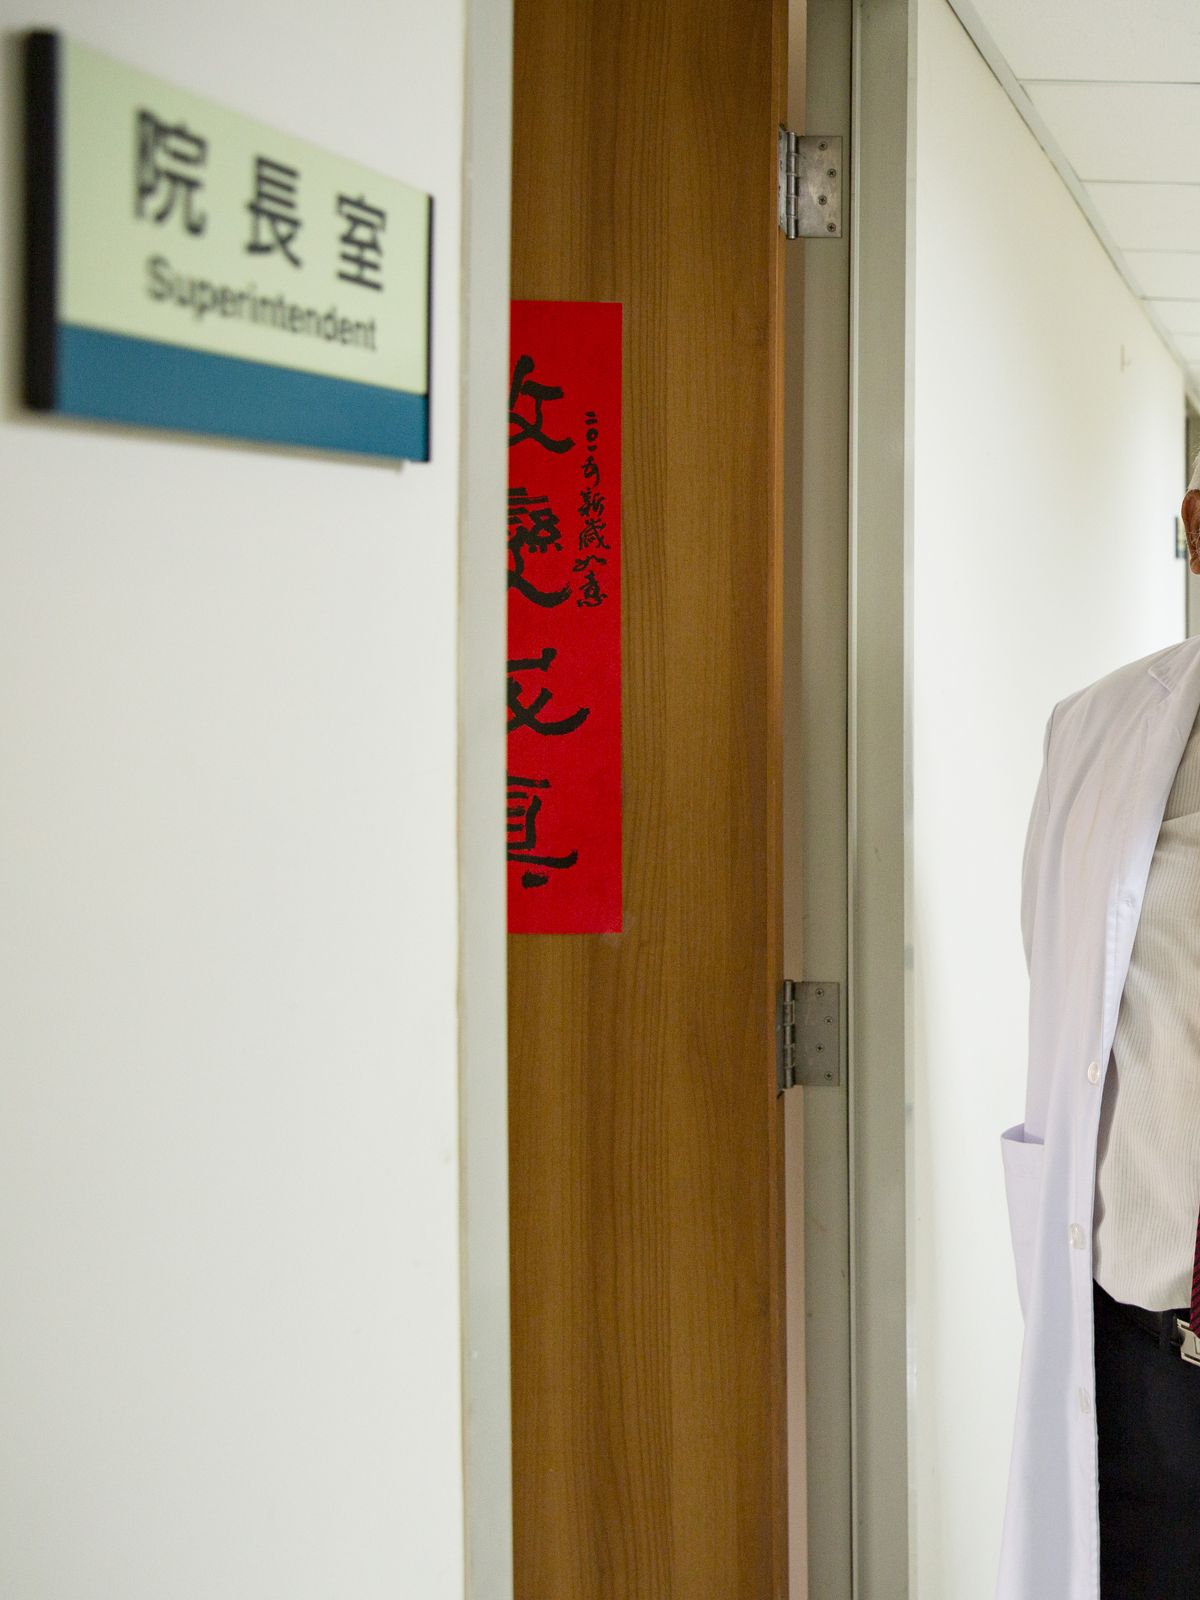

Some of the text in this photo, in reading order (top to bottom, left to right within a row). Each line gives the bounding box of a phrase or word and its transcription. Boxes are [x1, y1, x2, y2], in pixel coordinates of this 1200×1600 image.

[132, 104, 388, 293] 院長室
[145, 255, 378, 352] Superintendent
